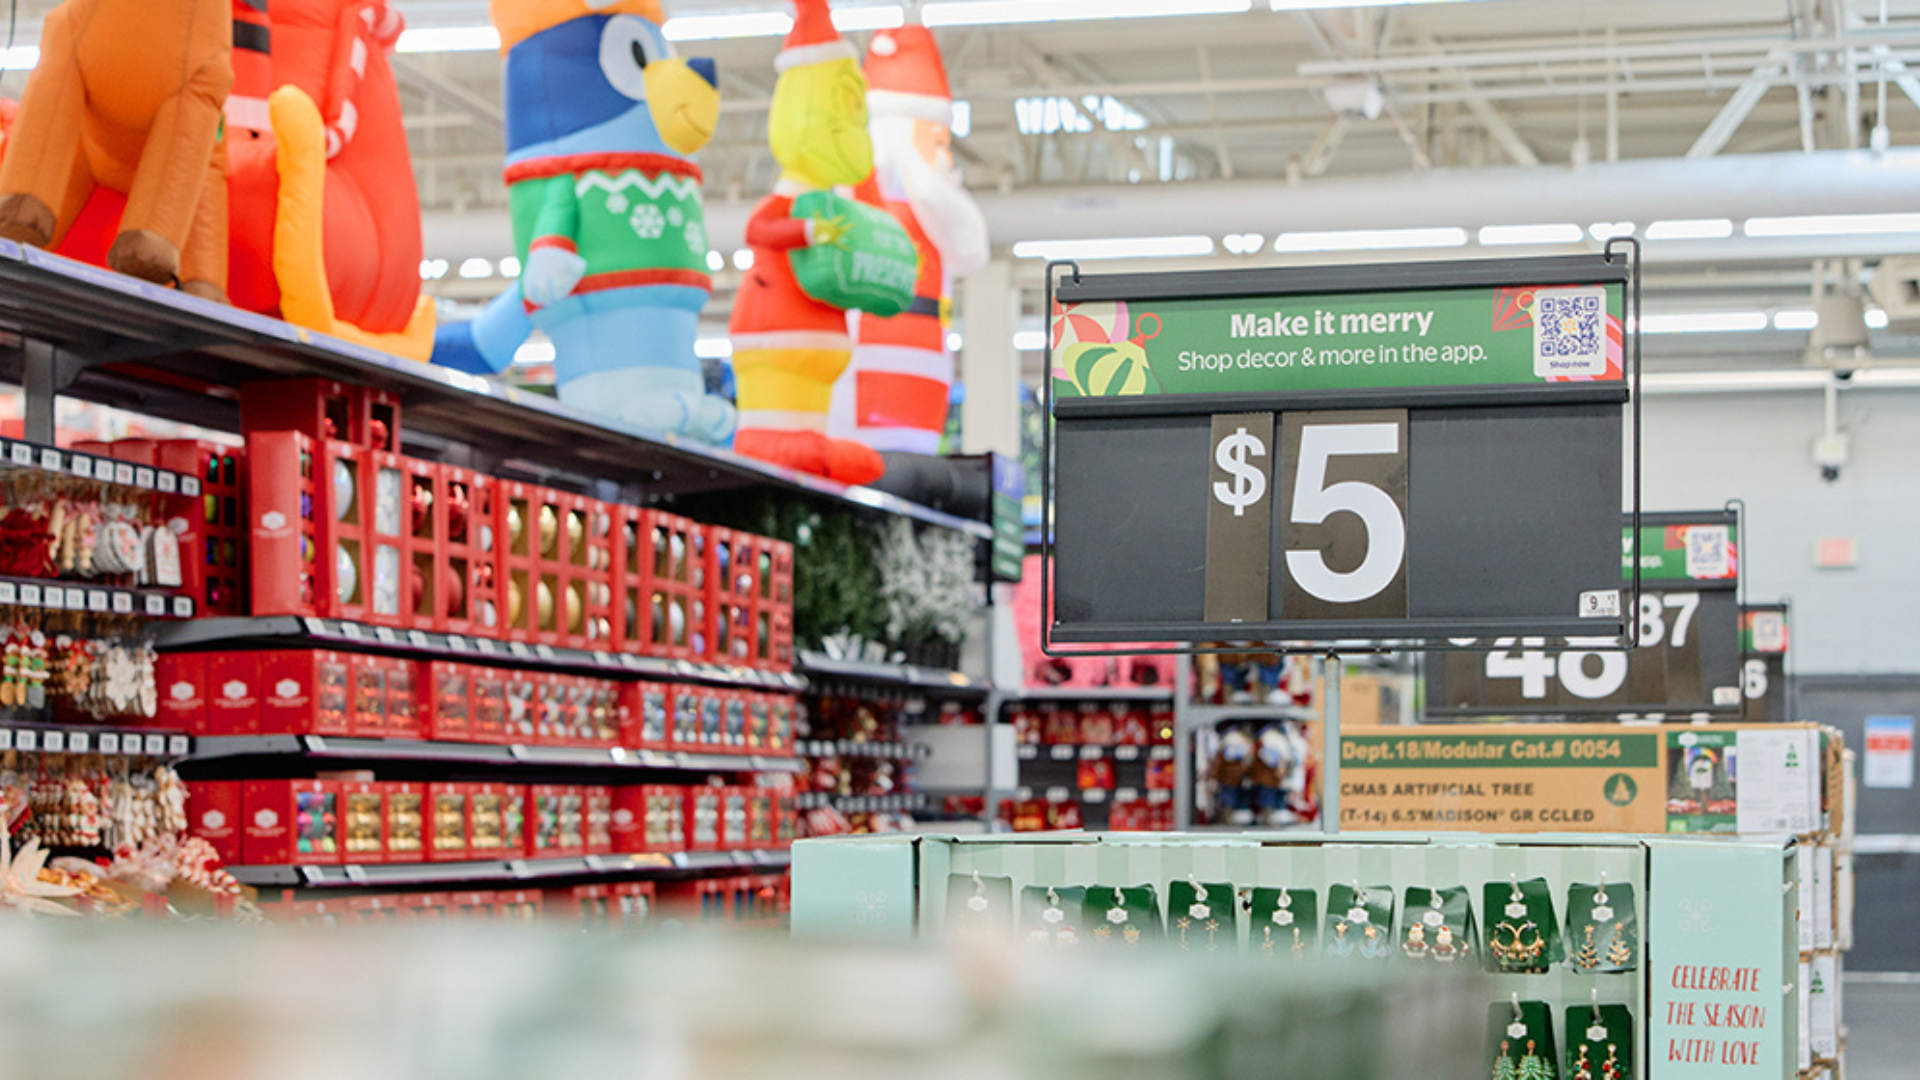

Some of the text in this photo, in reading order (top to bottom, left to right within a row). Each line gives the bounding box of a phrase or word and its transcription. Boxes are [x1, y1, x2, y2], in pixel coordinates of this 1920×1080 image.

[1230, 310, 1434, 338] Make it merry
[1178, 343, 1488, 373] Shop decor & more in the app.
[1628, 592, 1699, 647] 87
[1342, 740, 1621, 763] Dept.18/Modular Cat.# 0054
[1341, 783, 1534, 796] CMAS ARTIFICIAL TREE
[1510, 809, 1533, 822] GR
[1671, 964, 1761, 992] CELEBRATE
[1666, 1001, 1766, 1028] THE SEASON
[1668, 1038, 1760, 1066] WITH LOVE
